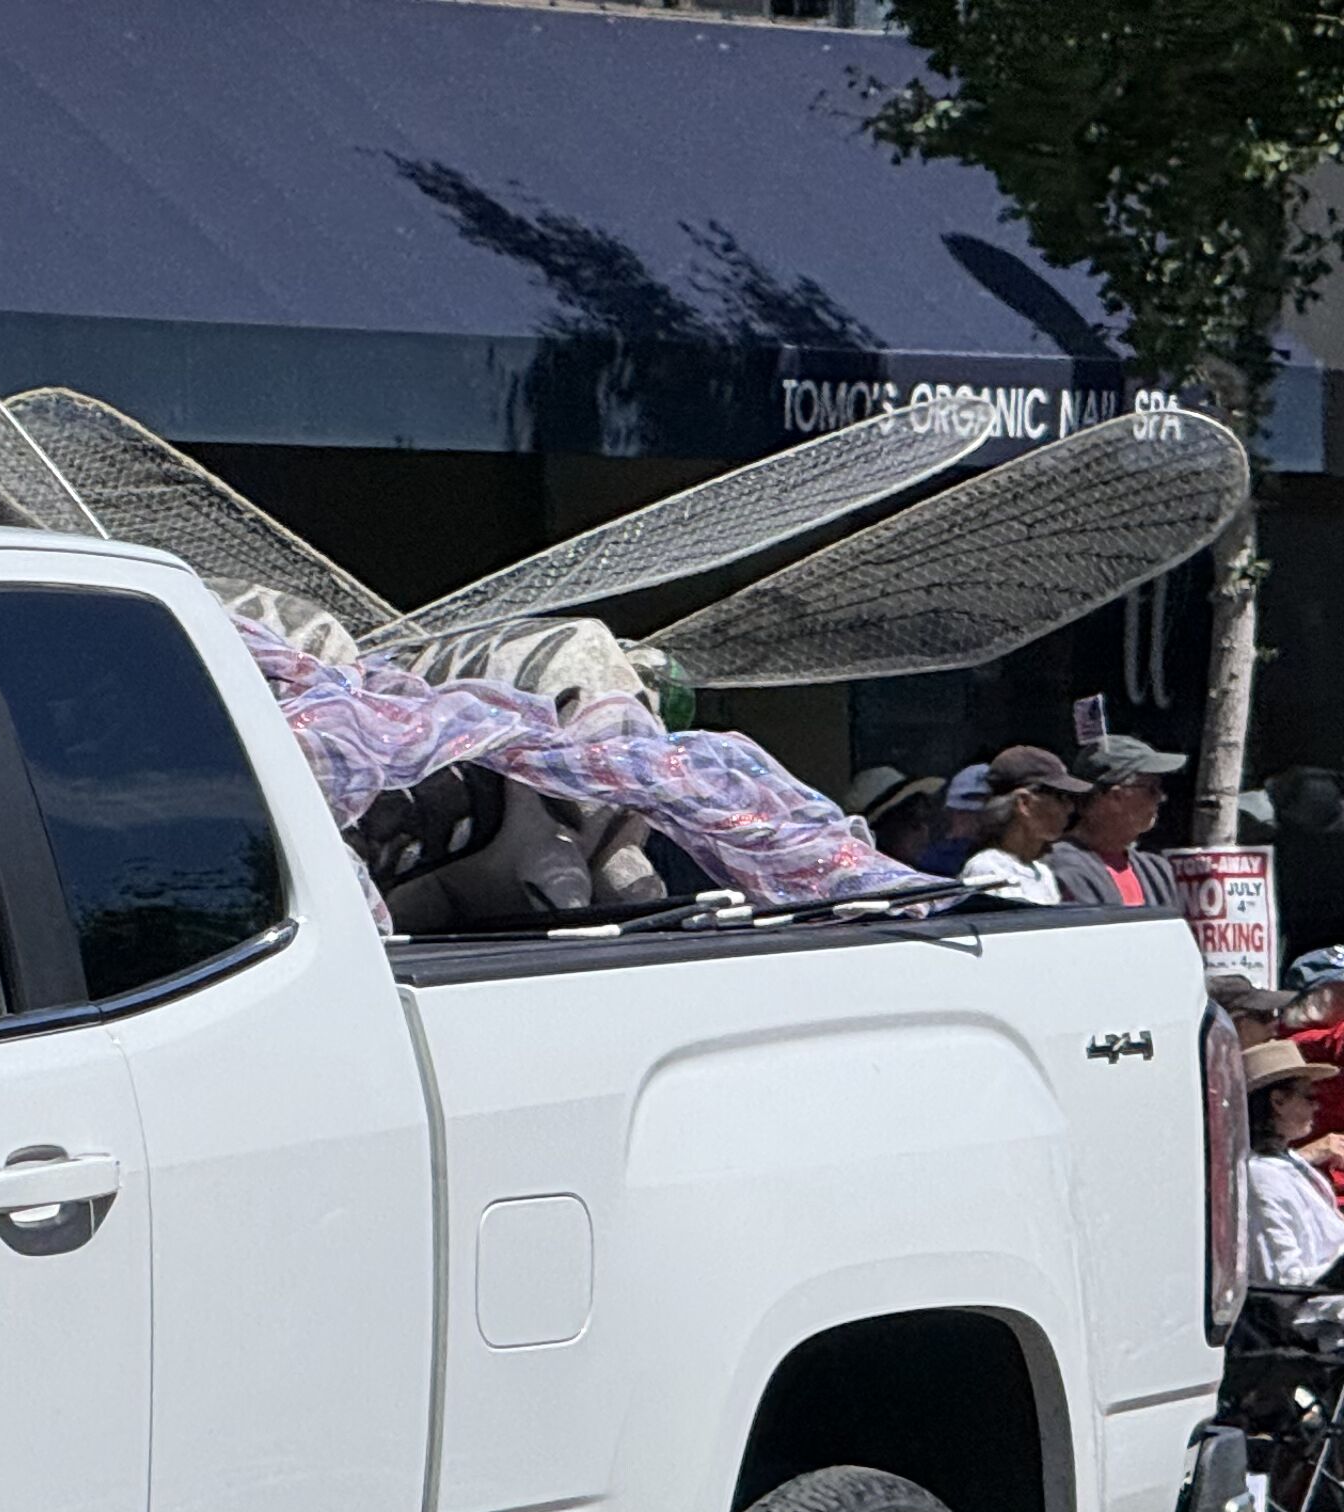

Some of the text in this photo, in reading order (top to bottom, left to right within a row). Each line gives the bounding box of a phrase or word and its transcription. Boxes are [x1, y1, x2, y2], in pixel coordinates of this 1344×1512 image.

[782, 379, 899, 432] TOMO'S
[911, 382, 1050, 441] ORGANIC
[1132, 388, 1185, 441] SPA
[1178, 879, 1223, 916] NO
[1228, 882, 1262, 896] JULY
[1190, 923, 1264, 953] RKING
